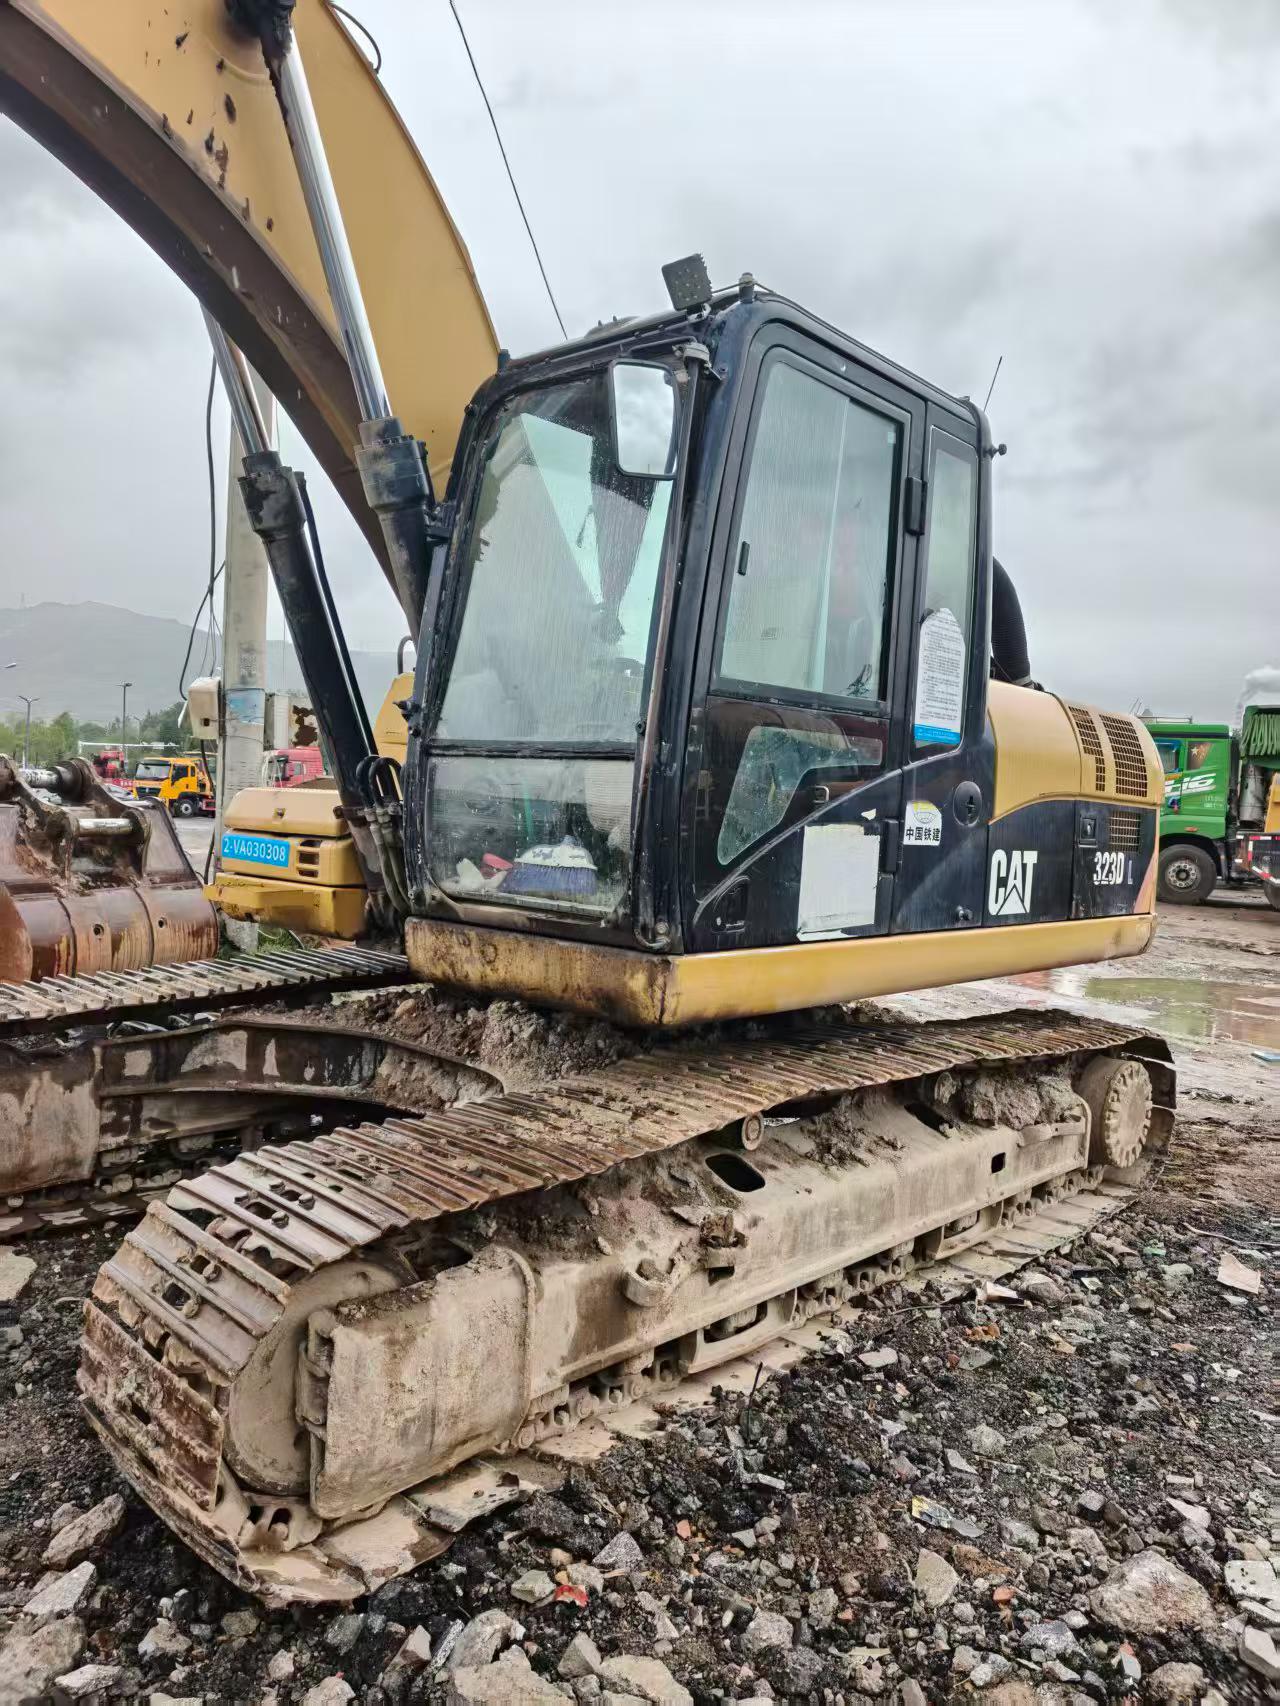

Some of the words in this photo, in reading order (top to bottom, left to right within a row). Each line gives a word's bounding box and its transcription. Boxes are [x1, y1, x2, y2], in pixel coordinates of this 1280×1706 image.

[905, 826, 941, 842] 中国铁建
[223, 837, 287, 862] 2-VA030308
[988, 848, 1038, 916] CAT
[1093, 851, 1125, 886] 323D
[1127, 860, 1133, 885] L
